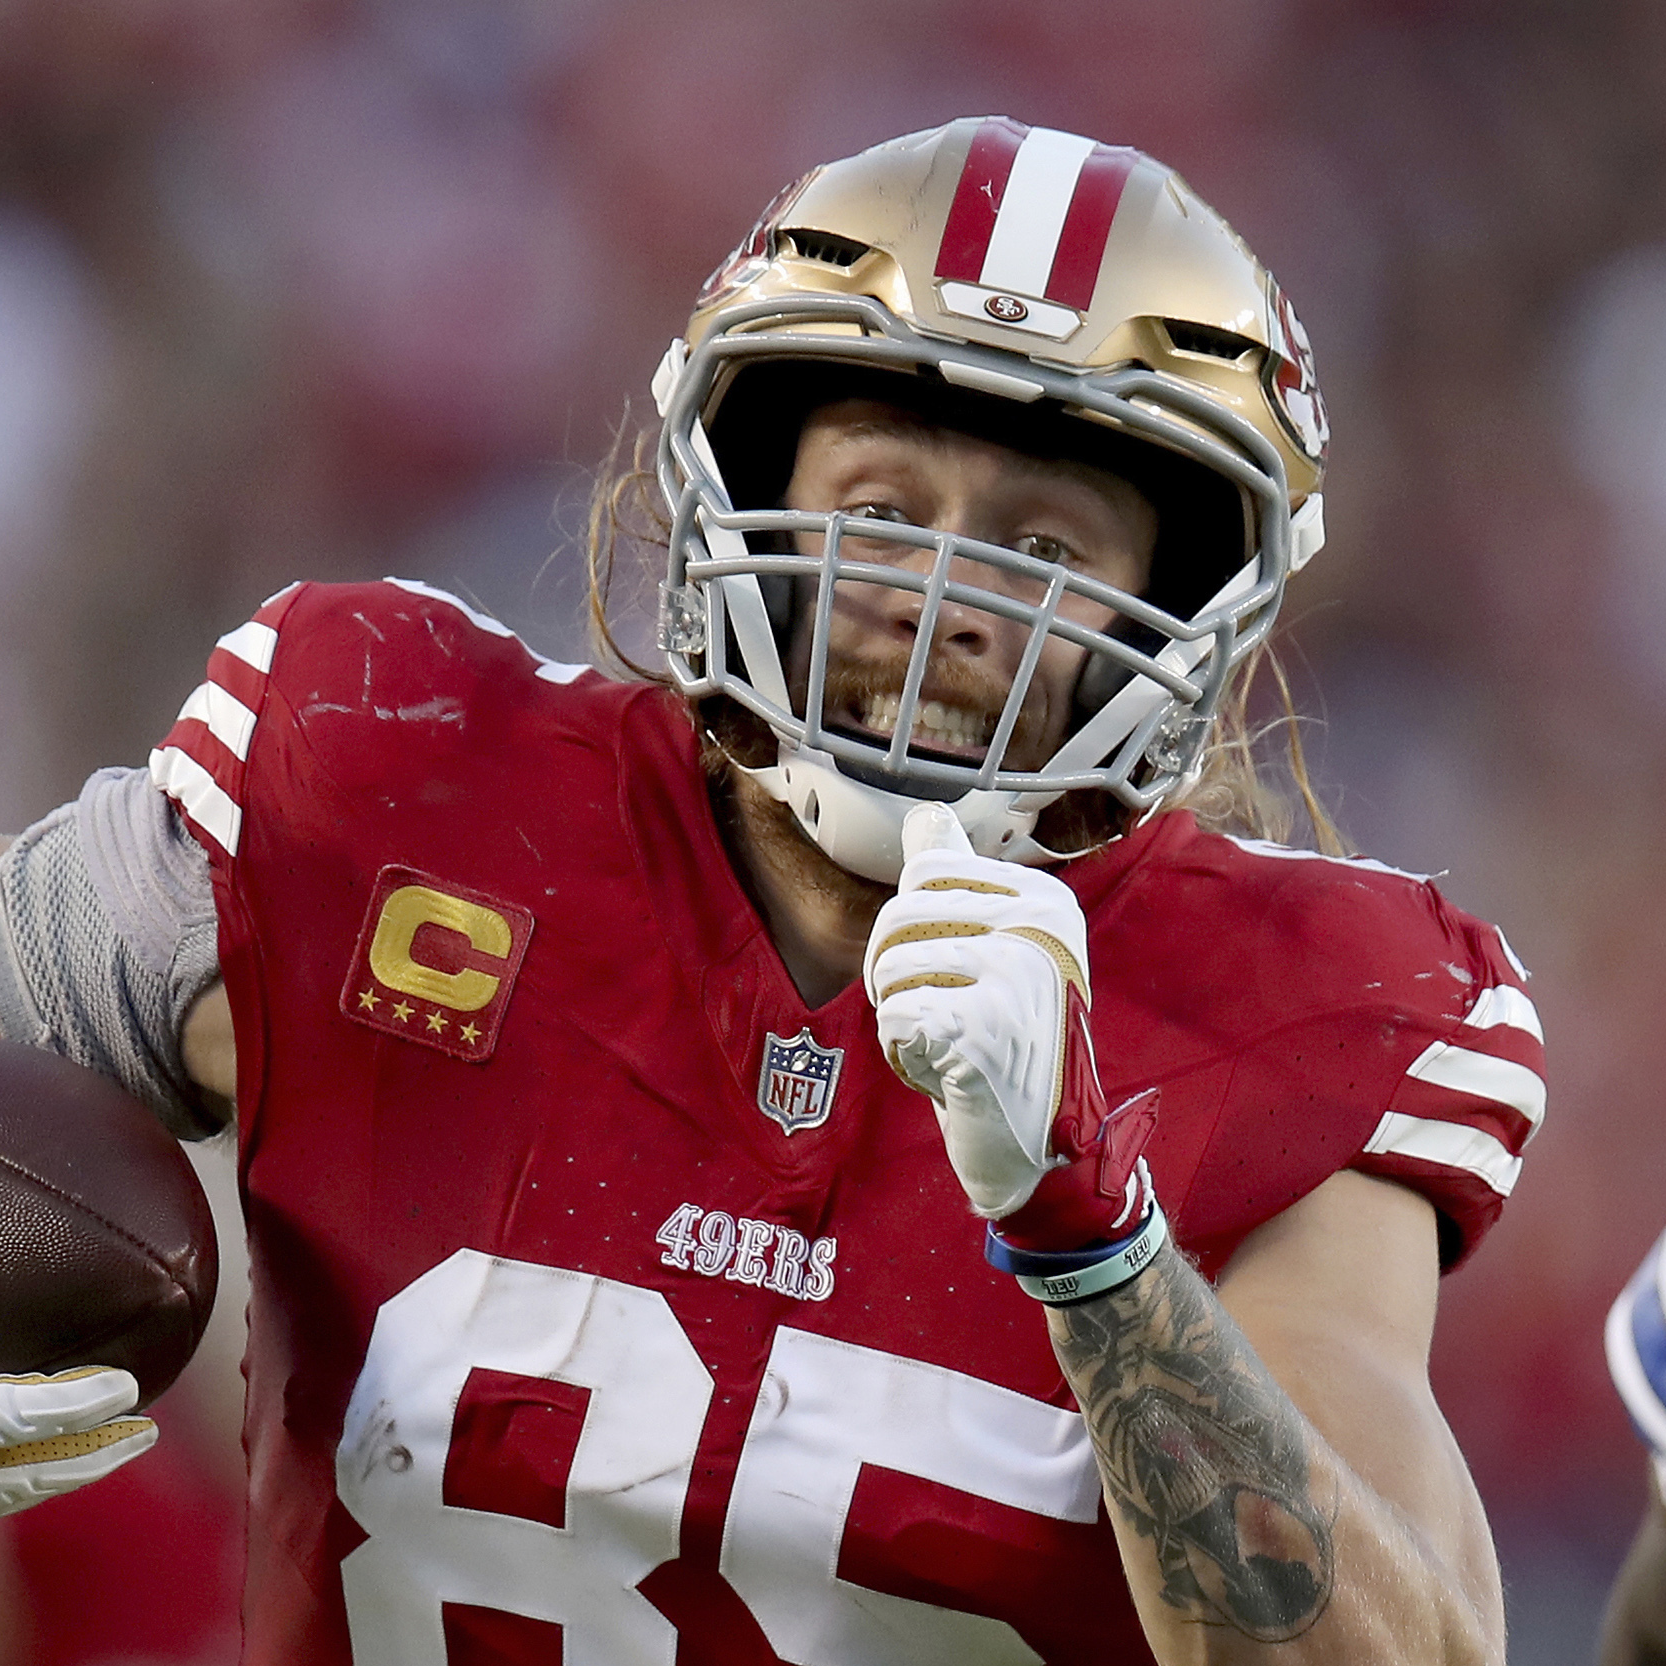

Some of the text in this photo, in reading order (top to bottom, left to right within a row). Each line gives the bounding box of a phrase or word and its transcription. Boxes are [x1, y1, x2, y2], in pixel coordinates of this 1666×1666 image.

[369, 885, 513, 1012] C
[767, 1073, 819, 1115] NFL
[655, 1202, 837, 1302] 49ERS
[1042, 1276, 1079, 1295] TEU
